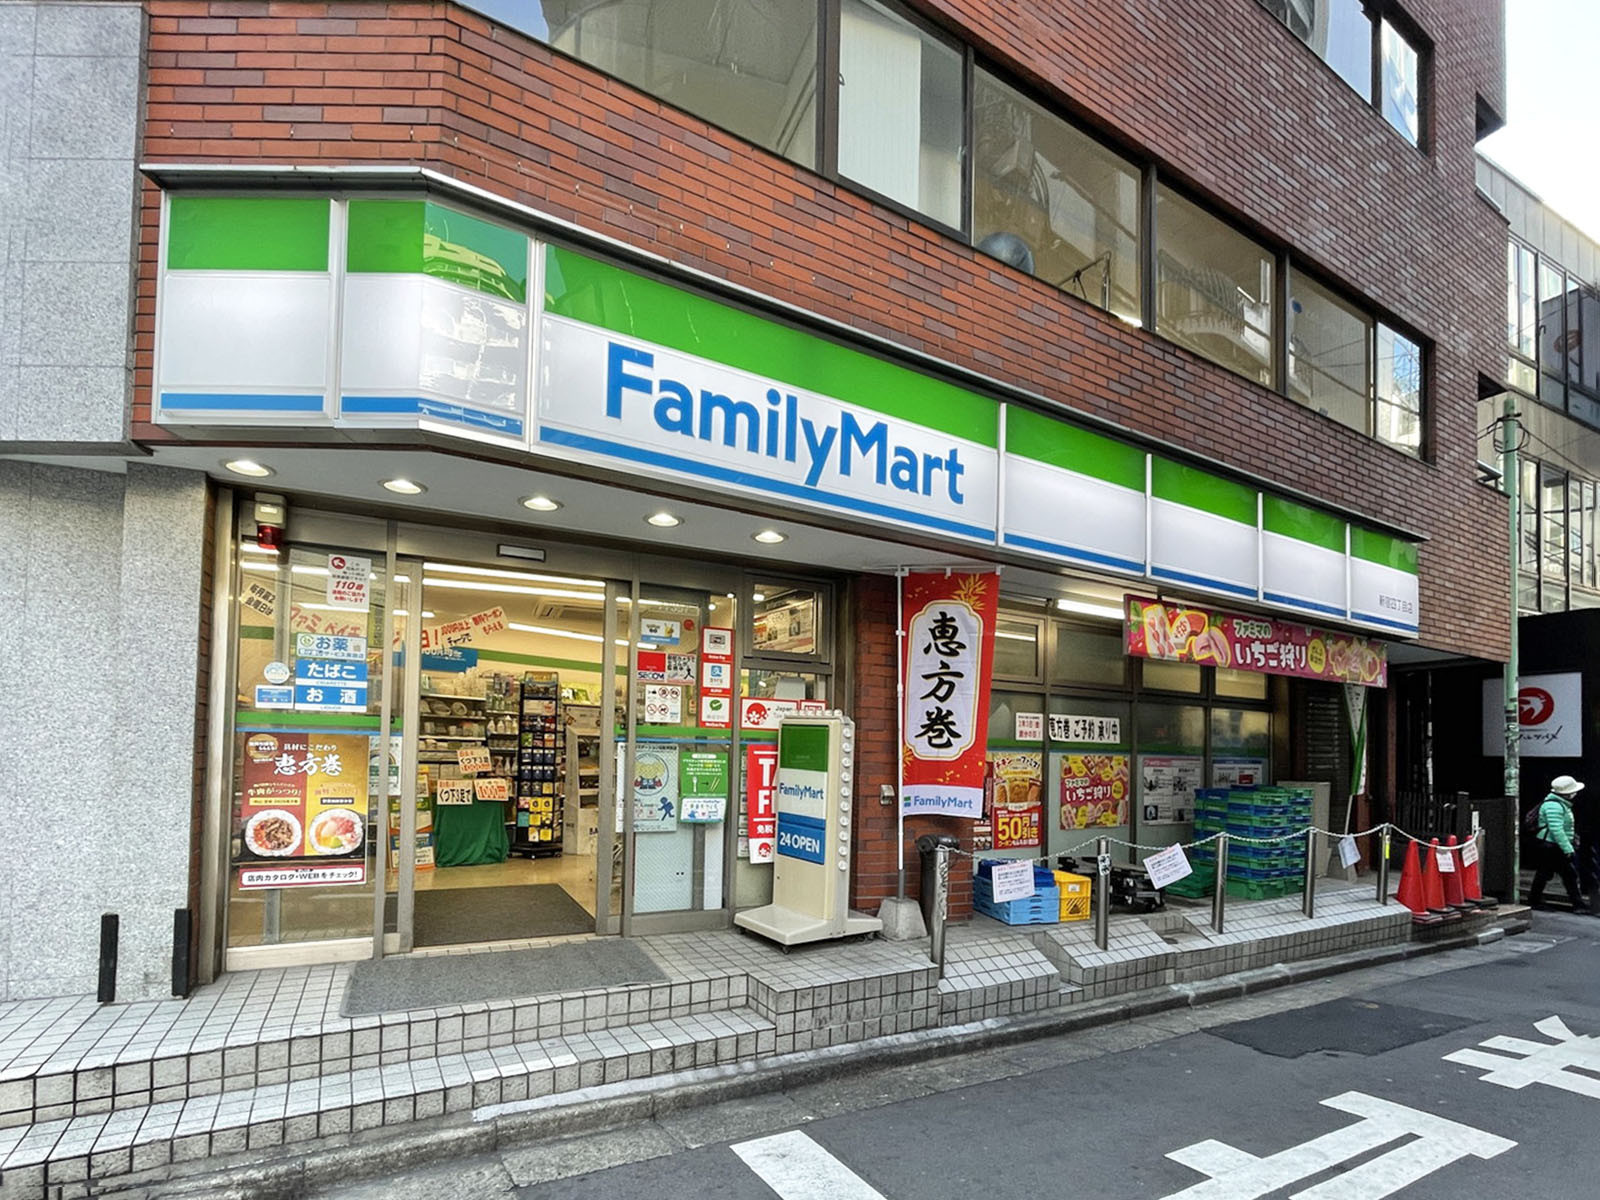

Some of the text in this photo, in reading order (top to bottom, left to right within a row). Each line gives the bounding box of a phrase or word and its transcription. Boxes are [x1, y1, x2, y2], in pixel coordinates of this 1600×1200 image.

[606, 340, 964, 505] FamilyMart
[245, 596, 274, 616] 金曜日は
[1233, 619, 1272, 638] ファミマの
[1235, 641, 1306, 670] いちご狩り
[307, 662, 357, 679] たばこ
[638, 671, 665, 680] SECOM
[914, 610, 967, 749] 恵方巻
[306, 687, 357, 704] お酒
[1073, 719, 1095, 740] ご予約
[1098, 720, 1120, 741] 承り中
[283, 743, 338, 751] 具材にこだわり
[274, 752, 343, 776] 恵方巻
[779, 782, 824, 800] FamilyMart
[1065, 785, 1111, 802] いちご狩り
[913, 795, 973, 810] FamilyMart
[779, 831, 821, 854] 24 OPEN
